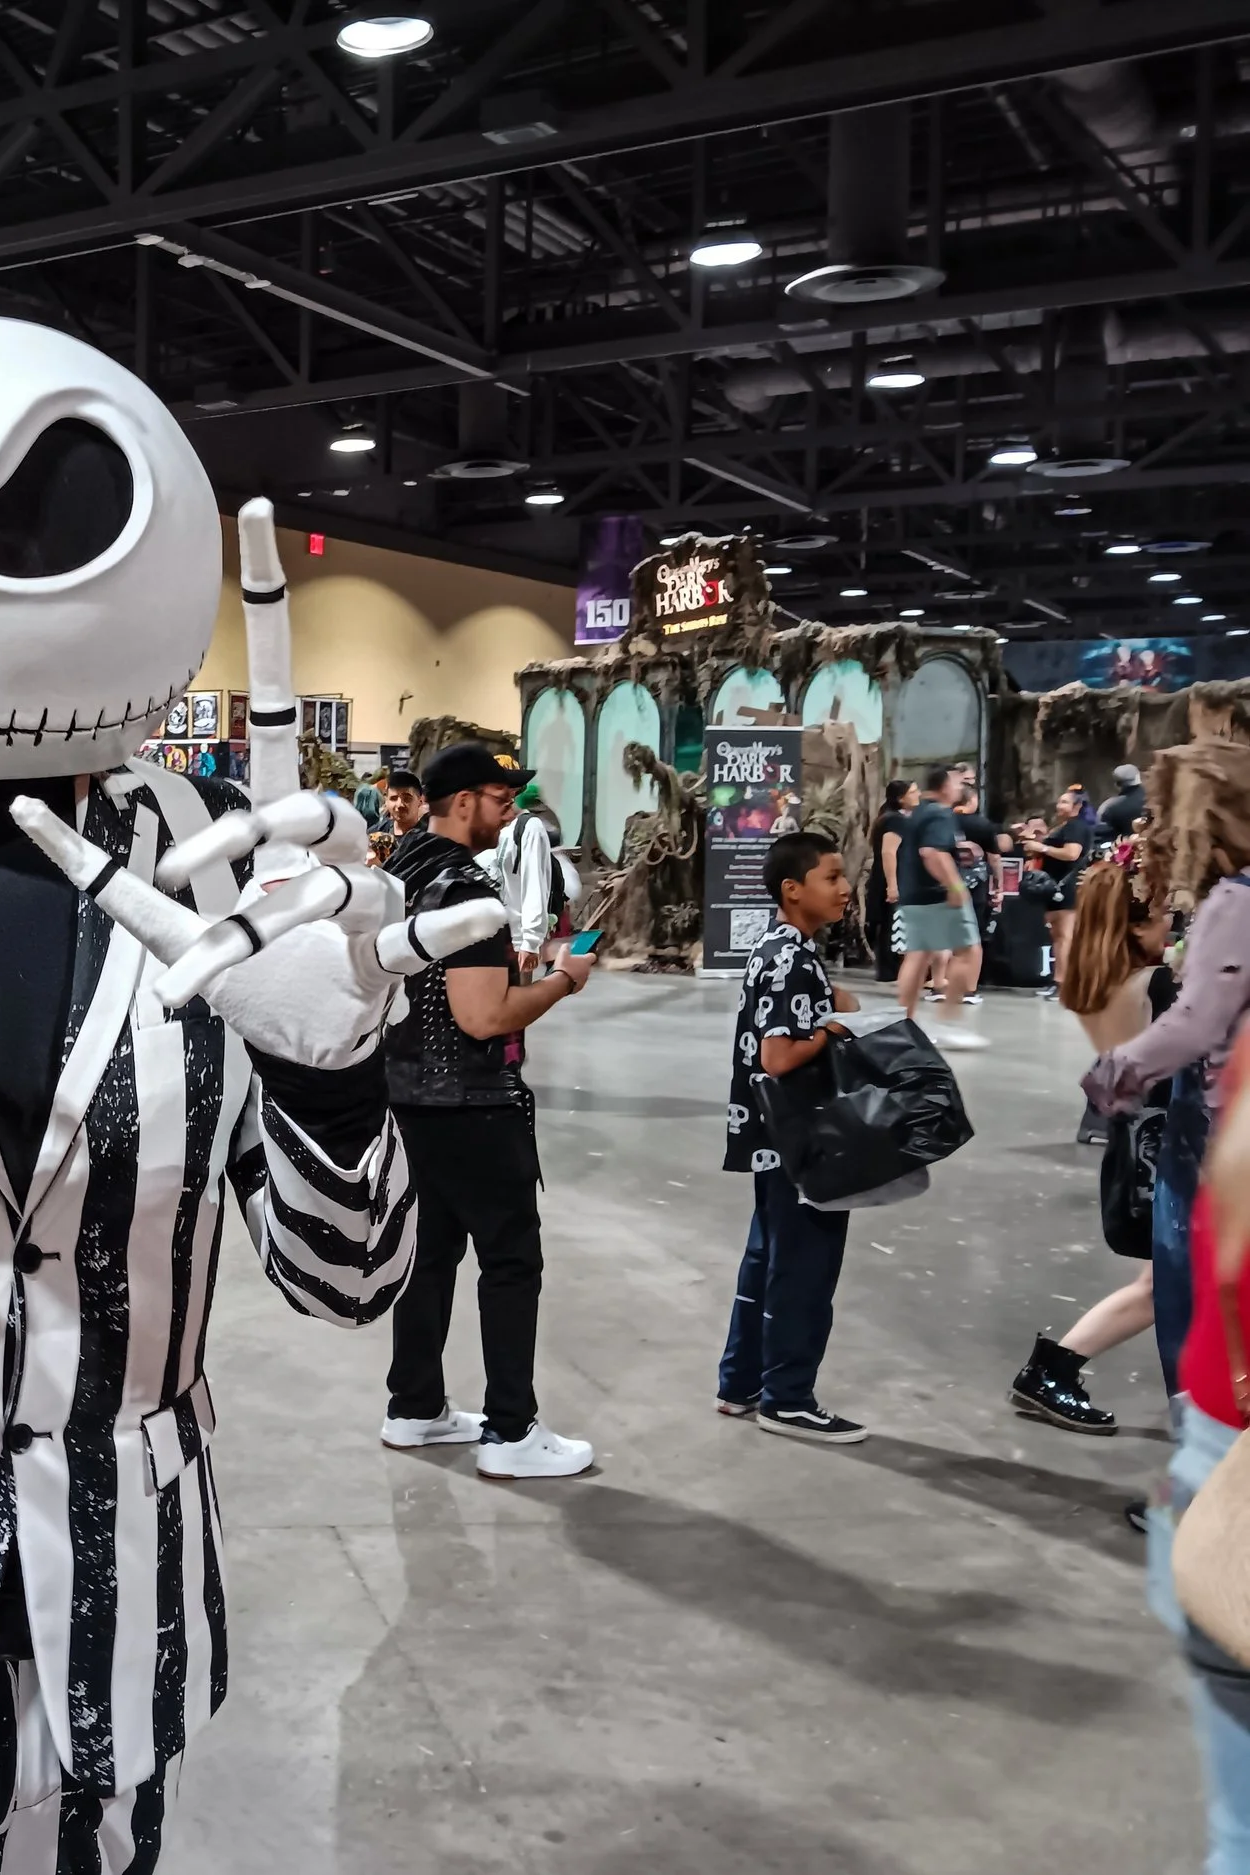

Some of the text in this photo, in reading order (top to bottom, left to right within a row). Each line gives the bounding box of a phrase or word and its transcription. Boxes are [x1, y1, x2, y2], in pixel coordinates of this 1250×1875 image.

[585, 598, 630, 628] 150
[726, 751, 768, 767] DARK
[713, 763, 795, 783] HARBOR
